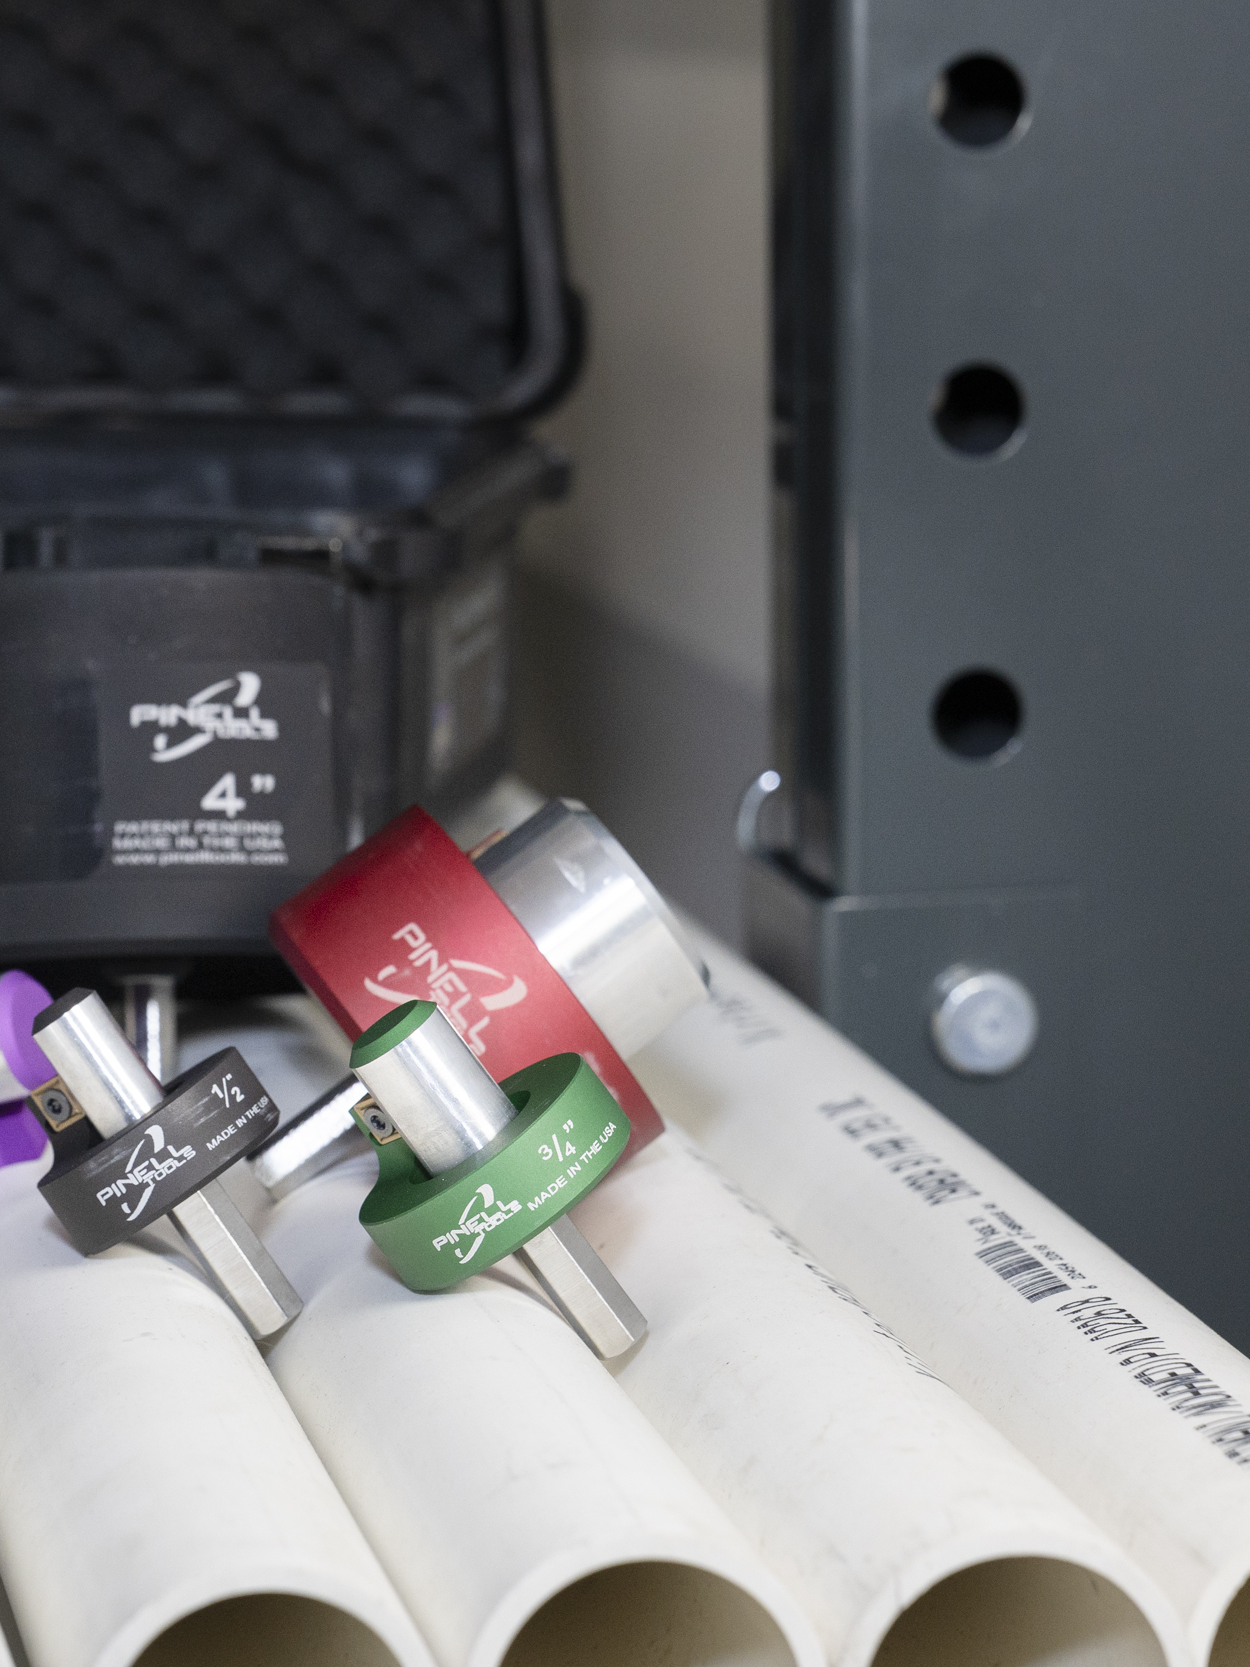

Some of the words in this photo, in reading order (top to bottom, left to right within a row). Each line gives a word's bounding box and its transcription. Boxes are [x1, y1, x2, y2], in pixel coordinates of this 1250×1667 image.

[130, 703, 262, 728] PINELL
[112, 835, 171, 851] MADE
[175, 835, 199, 851] IN
[202, 835, 239, 850] THE
[243, 835, 285, 850] USA
[113, 820, 190, 835] PATENT
[193, 819, 284, 835] PENDING
[392, 921, 491, 1054] PINELL
[206, 1124, 237, 1151] MADE
[235, 1115, 248, 1128] IN
[244, 1103, 261, 1119] THE
[96, 1144, 188, 1206] PINELL
[143, 1146, 196, 1186] TOOLS
[527, 1176, 568, 1211] MADE
[567, 1162, 581, 1178] IN
[580, 1142, 602, 1164] THE
[600, 1122, 617, 1144] USA
[432, 1200, 520, 1251] PINELL
[471, 1201, 523, 1236] TOOLS
